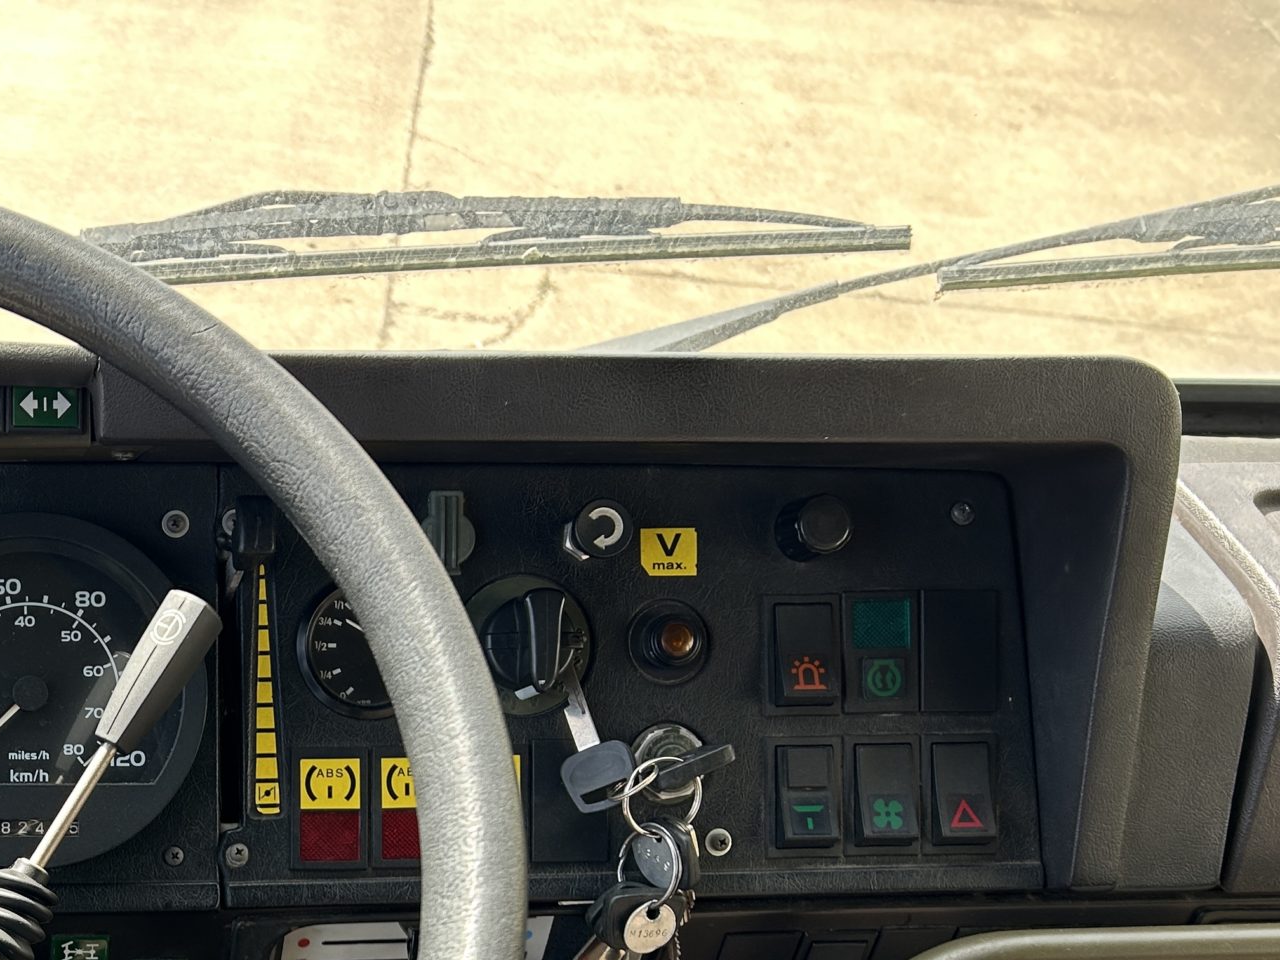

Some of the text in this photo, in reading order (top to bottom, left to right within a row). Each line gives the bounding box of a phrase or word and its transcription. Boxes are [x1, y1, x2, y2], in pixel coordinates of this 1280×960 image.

[655, 533, 682, 556] V
[651, 561, 687, 571] max.
[75, 591, 106, 607] 80
[15, 616, 35, 627] 40
[319, 616, 332, 626] 3/4
[61, 631, 82, 642] 50
[315, 641, 328, 651] 1/2
[83, 666, 104, 677] 60
[320, 670, 332, 680] 1/4
[84, 708, 104, 719] 70
[8, 751, 50, 760] miles/h
[63, 744, 84, 756] 80
[9, 770, 49, 783] km/h
[316, 768, 344, 778] ABS
